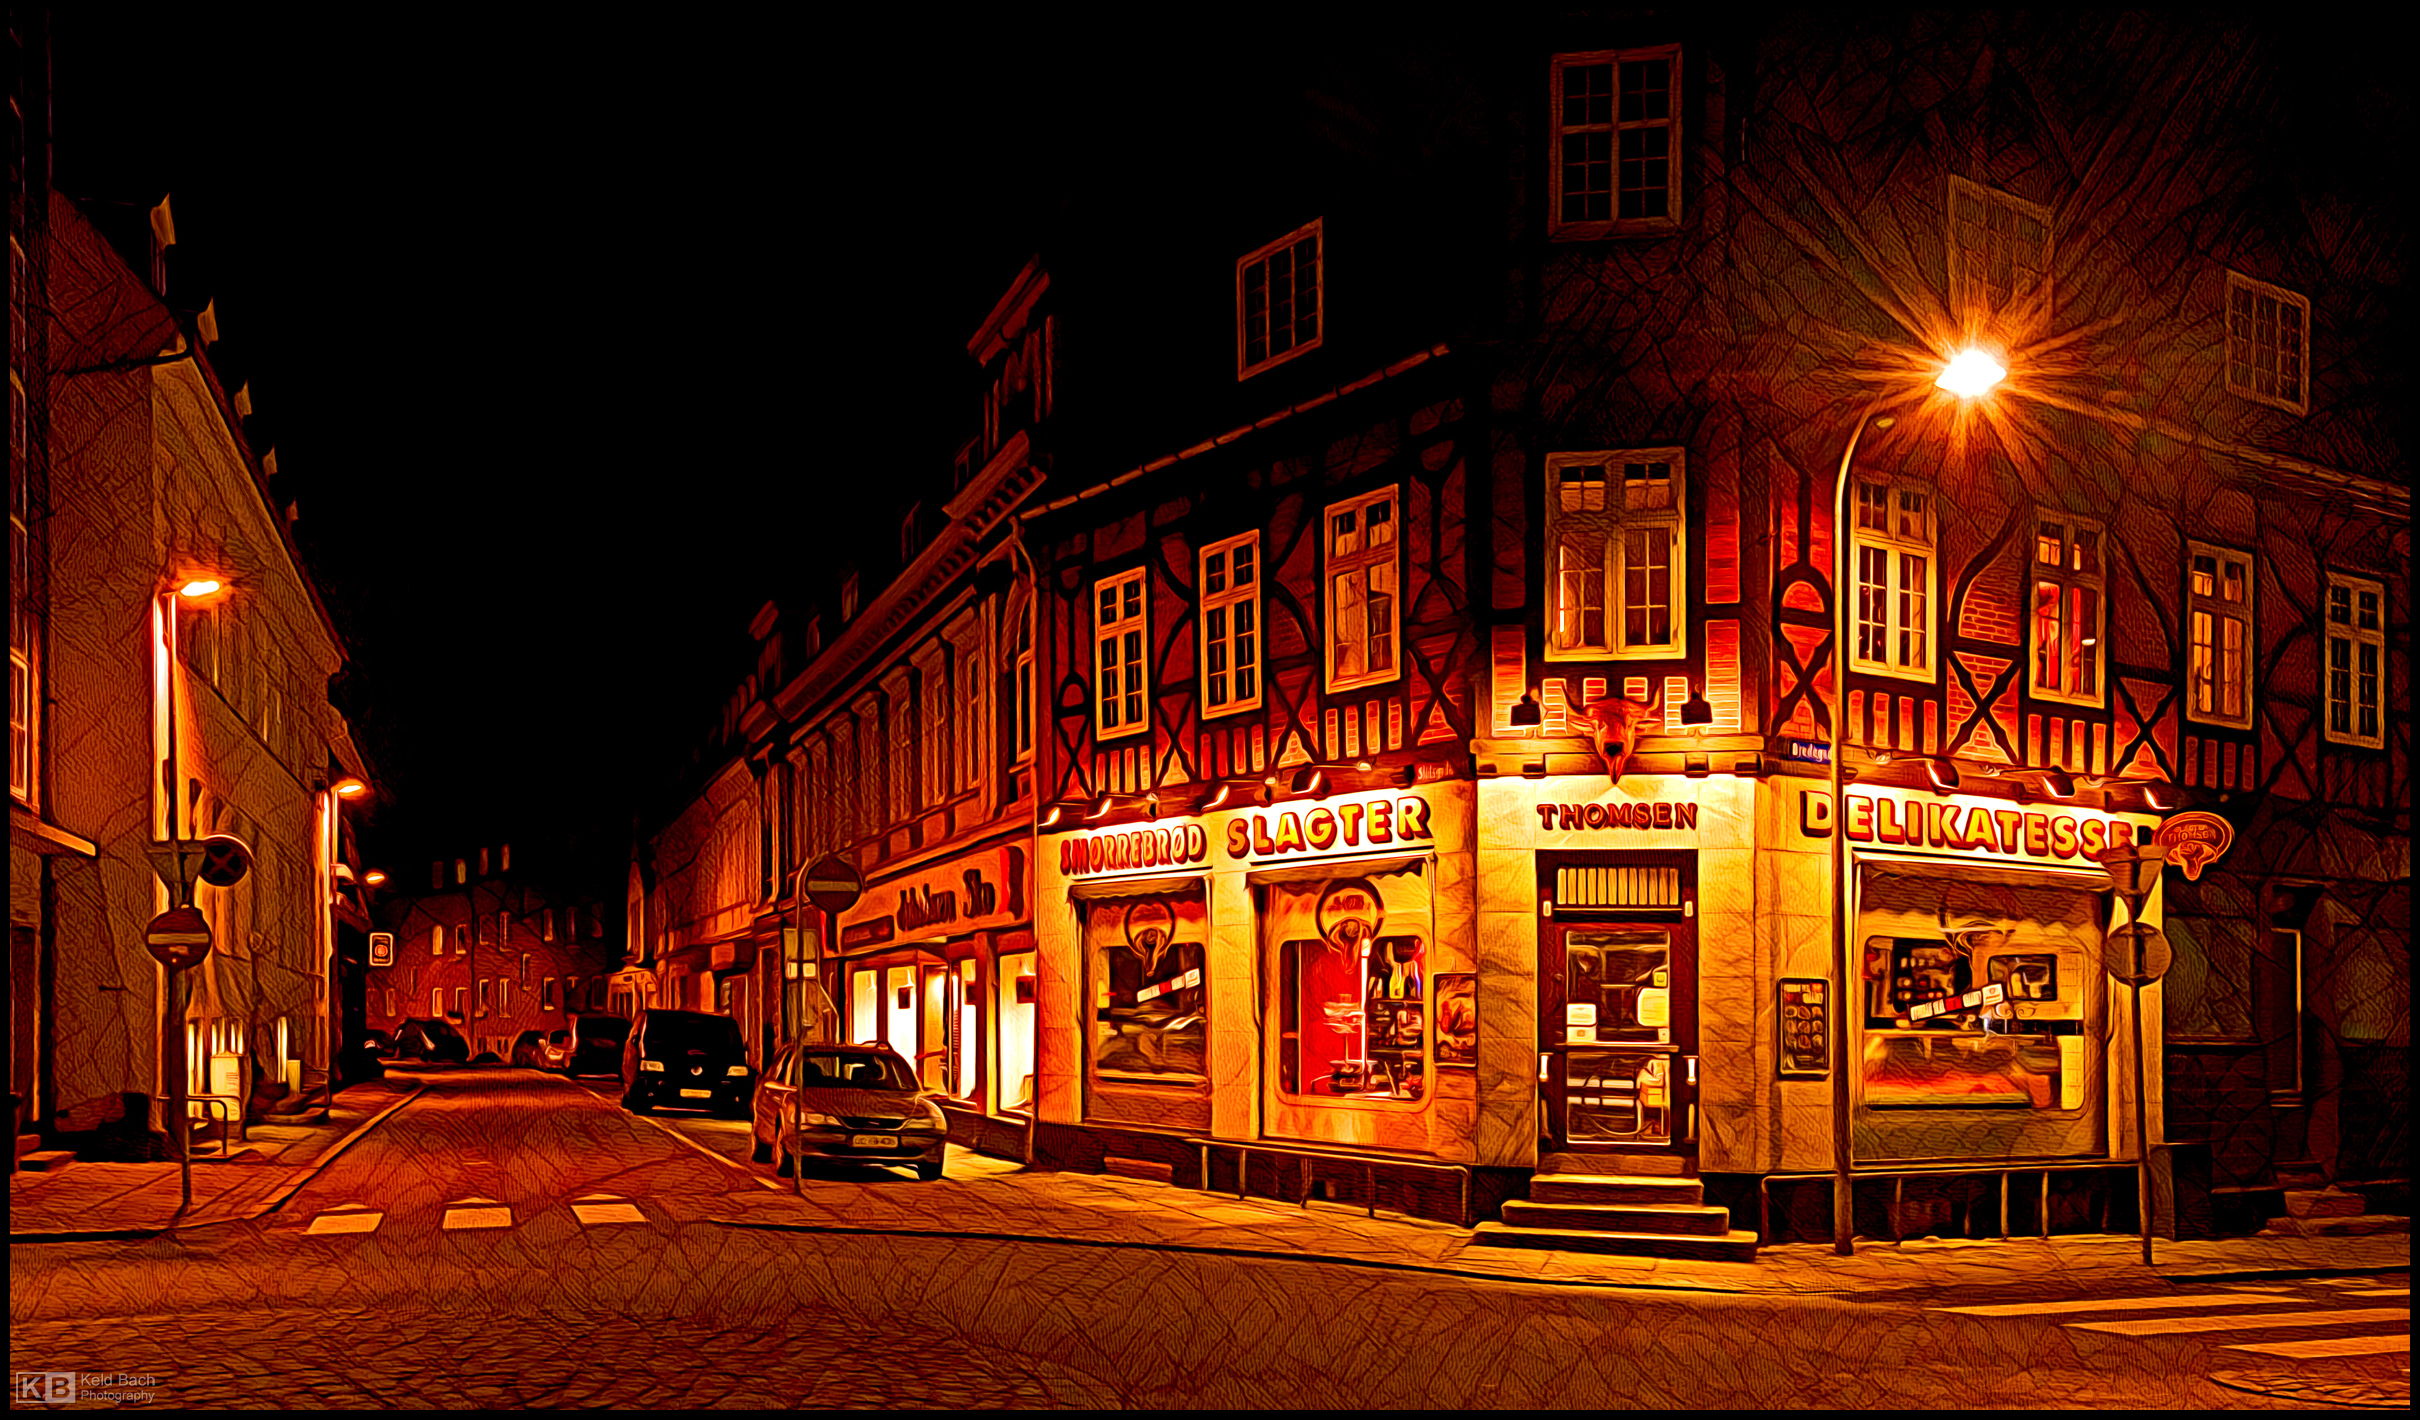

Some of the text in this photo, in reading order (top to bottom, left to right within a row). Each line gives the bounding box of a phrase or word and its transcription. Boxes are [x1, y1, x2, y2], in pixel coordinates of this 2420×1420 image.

[1227, 796, 1433, 859] SLAGTER
[1536, 802, 1699, 831] THOMSEN
[1060, 823, 1207, 876] SMØRREBRØD
